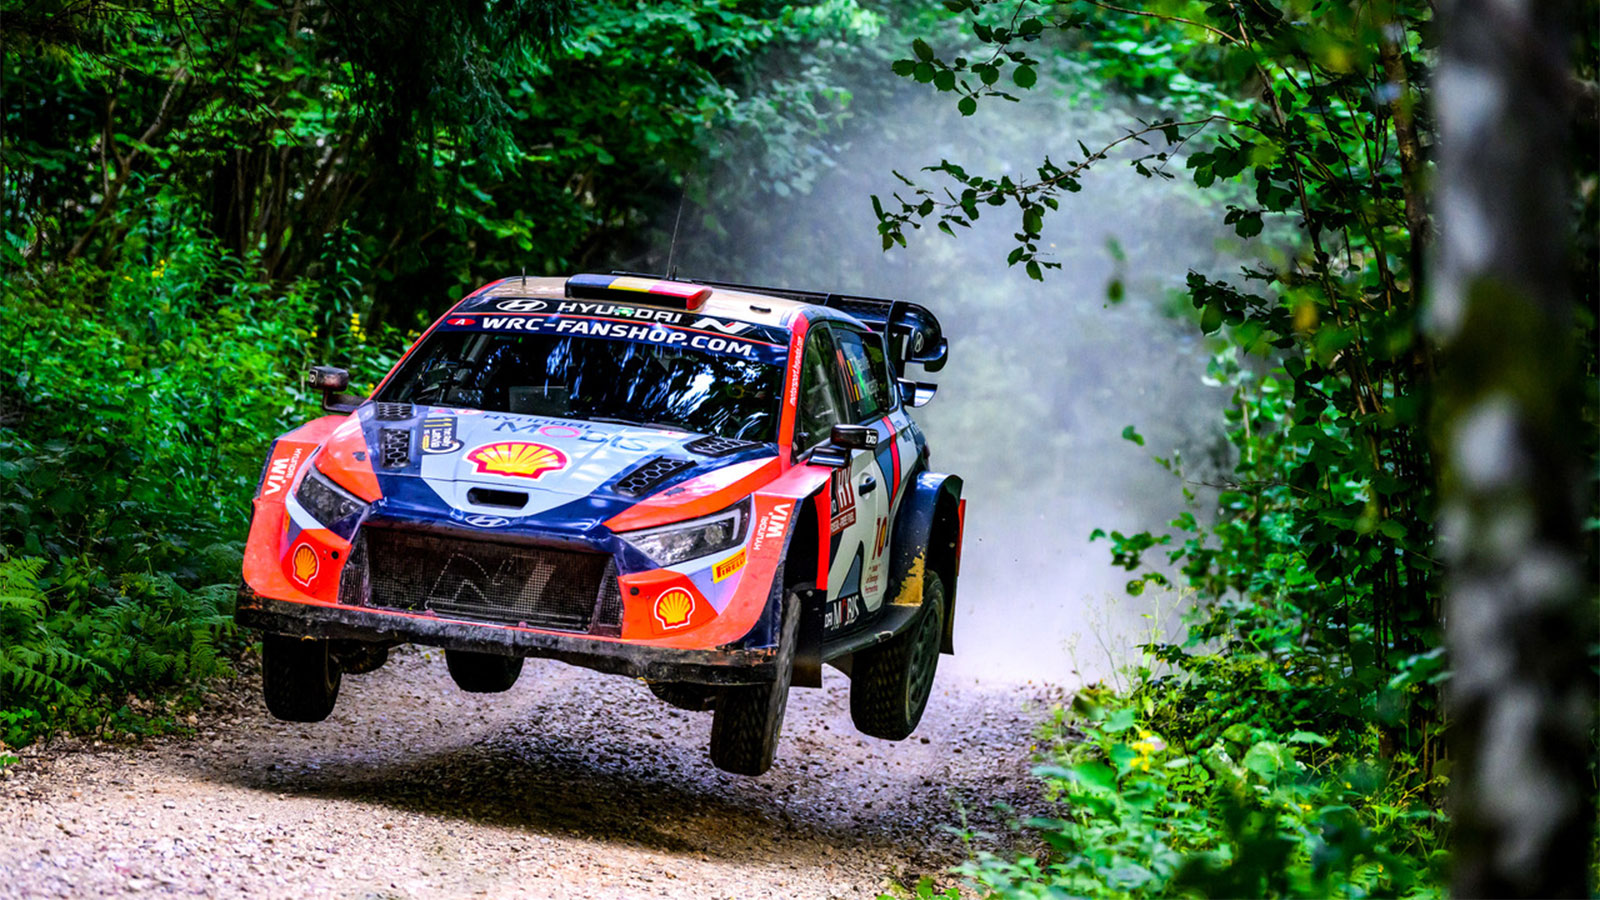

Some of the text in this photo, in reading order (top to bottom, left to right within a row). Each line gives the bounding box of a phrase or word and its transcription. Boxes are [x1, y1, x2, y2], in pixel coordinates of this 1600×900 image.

[481, 317, 753, 356] WRC-FANSHOP.COM
[483, 414, 591, 430] HYUNDAI
[285, 447, 303, 479] HYUNDAI
[753, 515, 769, 551] HYUNDAI
[716, 551, 745, 578] PIRELLI
